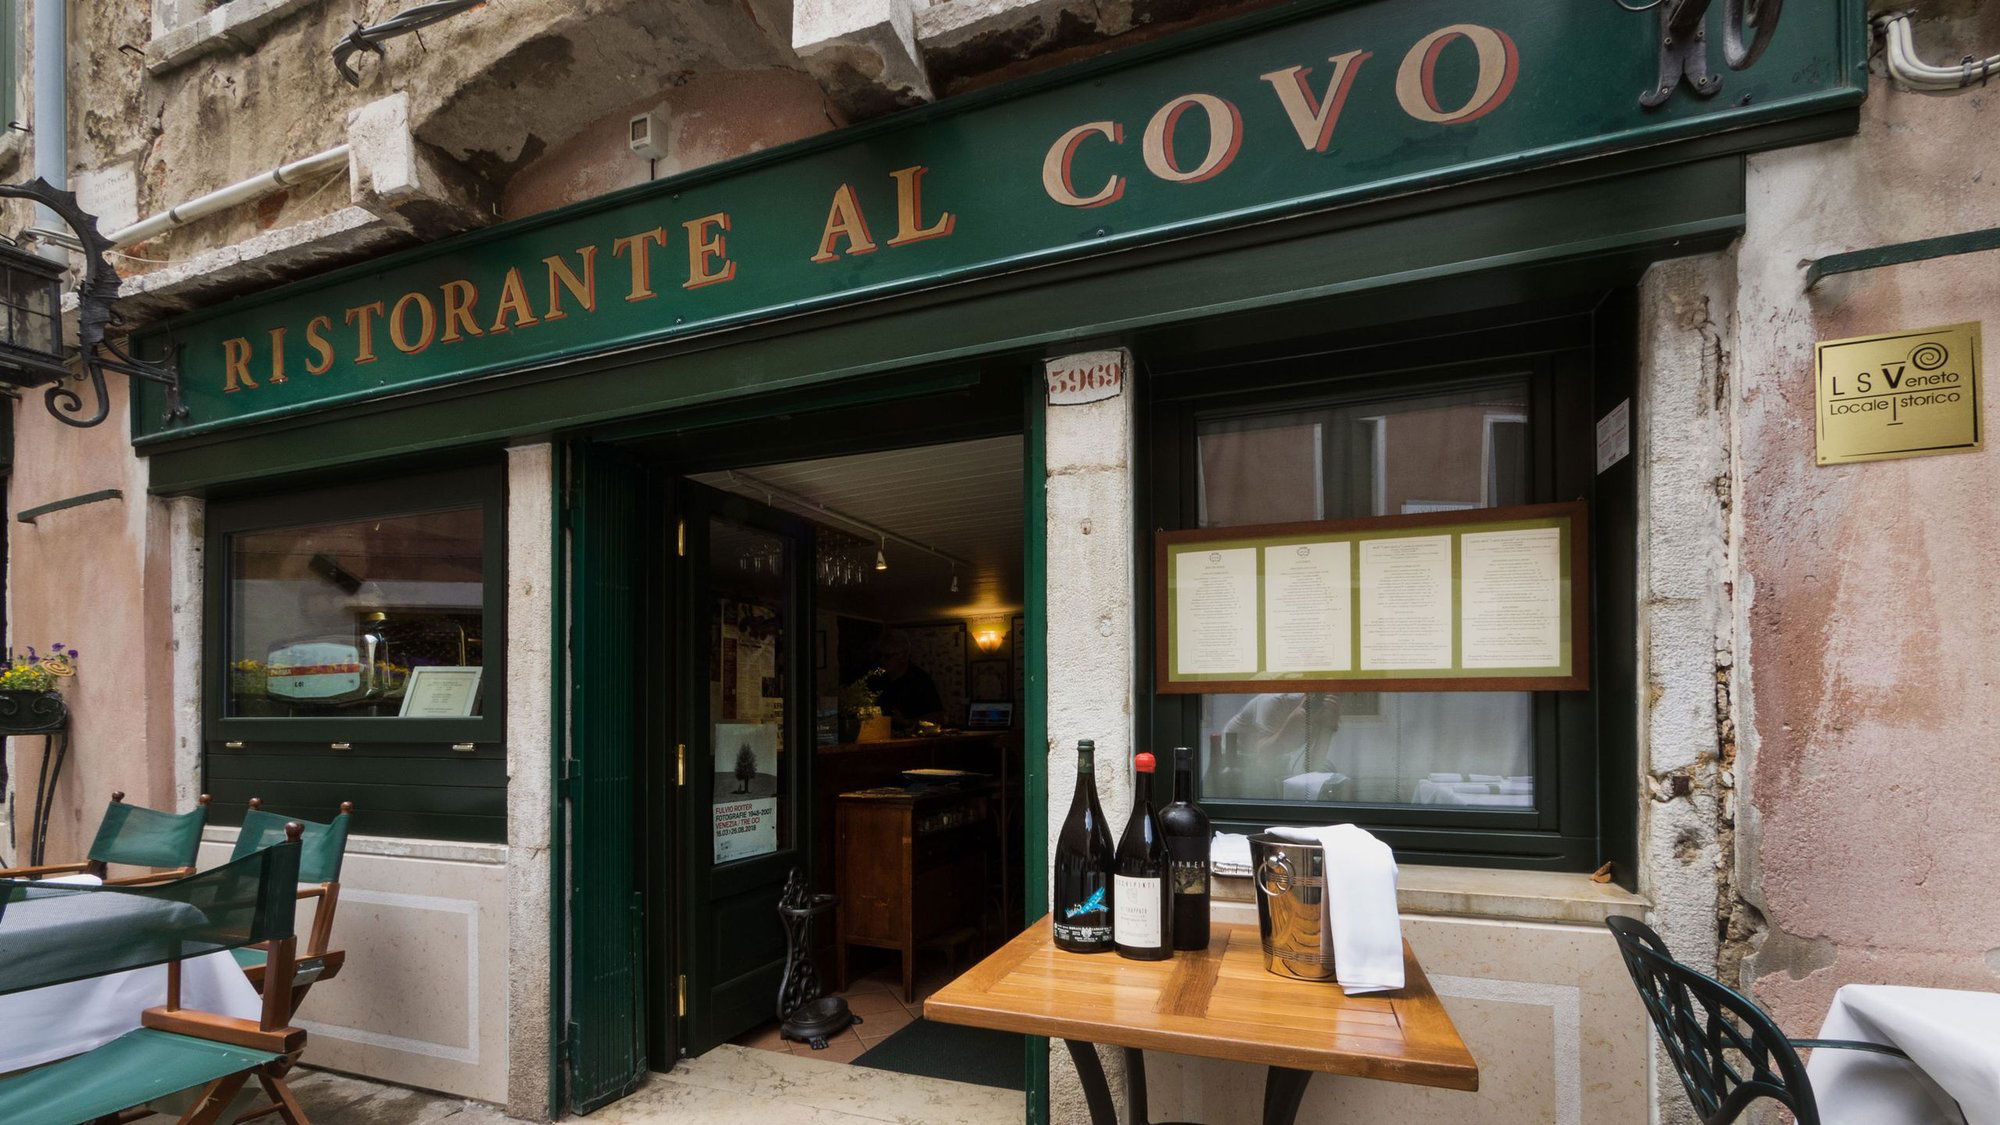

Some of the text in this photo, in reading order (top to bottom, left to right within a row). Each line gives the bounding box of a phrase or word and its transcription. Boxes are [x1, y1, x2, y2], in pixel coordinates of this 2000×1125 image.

[222, 23, 1520, 393] RISTORANTE AL COVO
[1050, 363, 1121, 393] 5969
[1830, 392, 1961, 416] Locale storico
[715, 805, 733, 815] FULVIO
[715, 812, 747, 822] FOTOGRAFIE
[715, 820, 738, 830] VENEZIA
[741, 818, 750, 826] TRE
